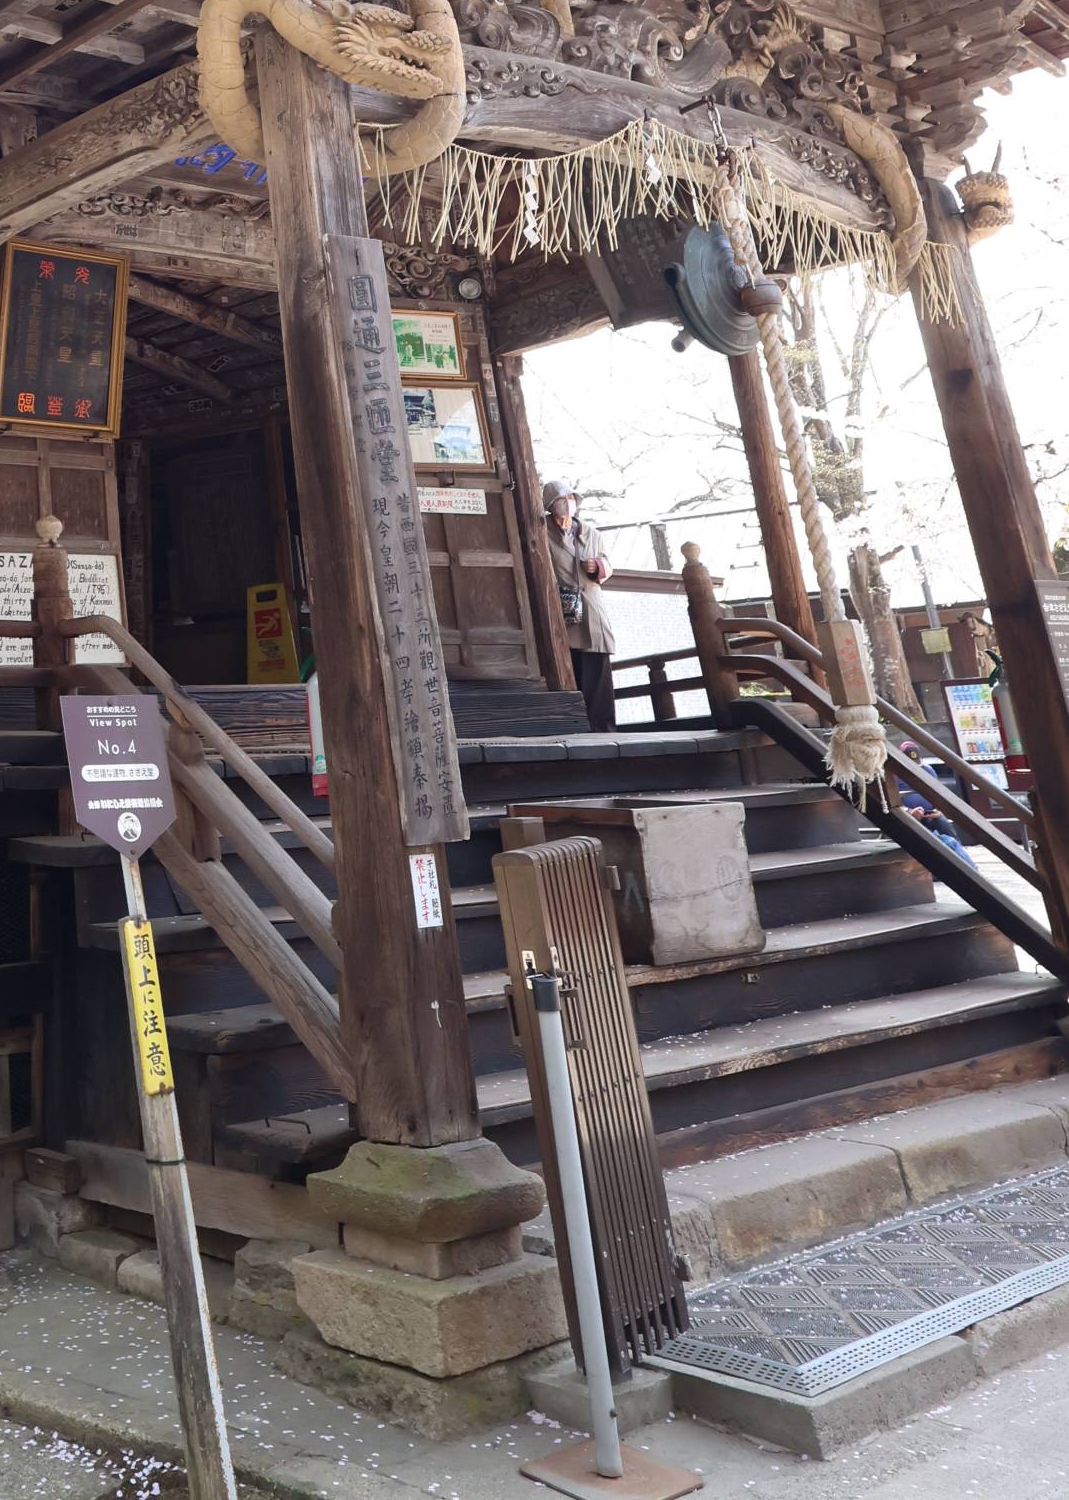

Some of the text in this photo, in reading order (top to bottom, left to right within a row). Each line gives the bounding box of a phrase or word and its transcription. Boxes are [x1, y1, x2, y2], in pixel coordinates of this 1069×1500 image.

[3, 595, 26, 606] thirty
[82, 640, 99, 652] after
[89, 718, 138, 728] View Spot
[97, 739, 137, 755] No.4
[414, 858, 430, 924] 禁止します
[133, 933, 166, 1077] 頭上に注意
